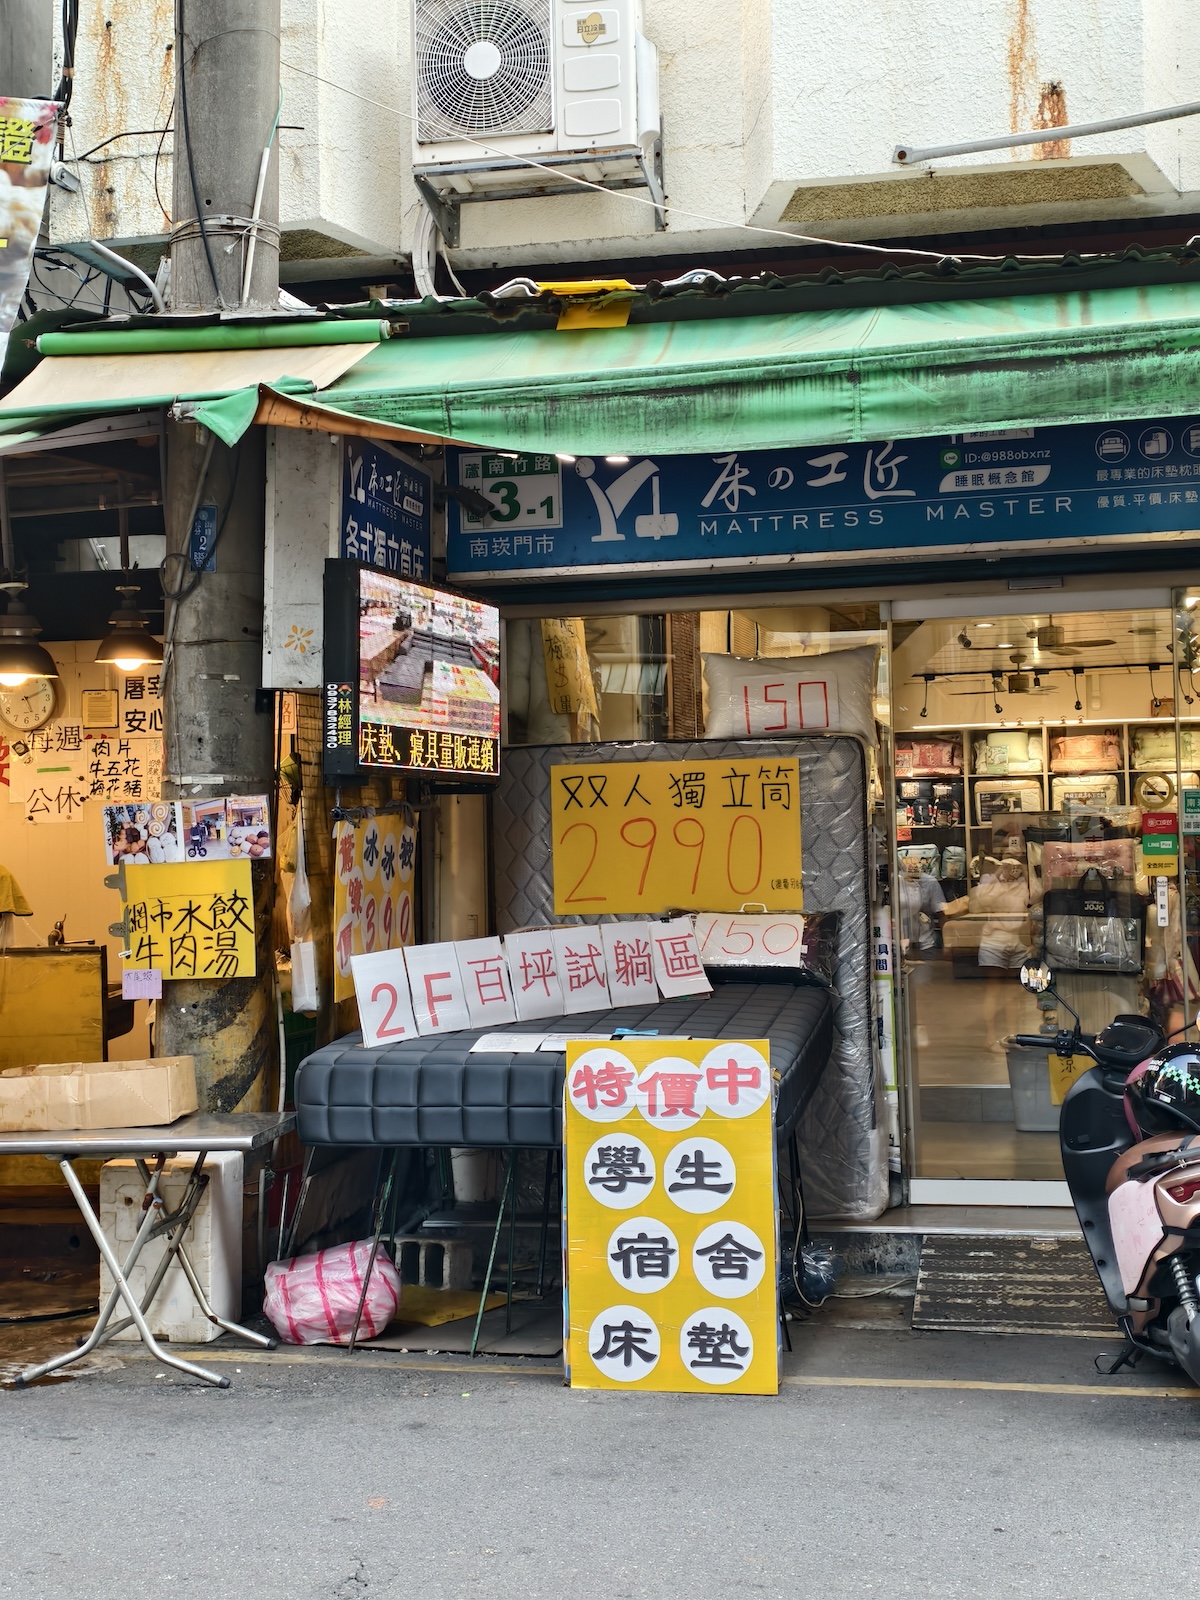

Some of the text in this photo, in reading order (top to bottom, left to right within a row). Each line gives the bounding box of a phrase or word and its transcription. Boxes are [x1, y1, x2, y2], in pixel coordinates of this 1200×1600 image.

[488, 455, 552, 474] 南竹路
[955, 470, 1035, 487] 睡眠概念館
[367, 498, 398, 520] MATTRESS
[401, 514, 423, 532] MASTER
[701, 496, 1072, 536] MATTRESS MASTER
[469, 534, 554, 558] 南崁門市
[337, 698, 352, 746] 林經理
[743, 680, 829, 735] 150
[27, 785, 82, 815] 公休
[560, 815, 763, 904] 2990
[135, 931, 239, 978] 牛肉湯
[700, 919, 799, 955] 150
[572, 1058, 761, 1118] 特價中
[589, 1145, 734, 1194] 學生
[610, 1232, 764, 1281] 宿舍
[591, 1319, 749, 1370] 床墊
